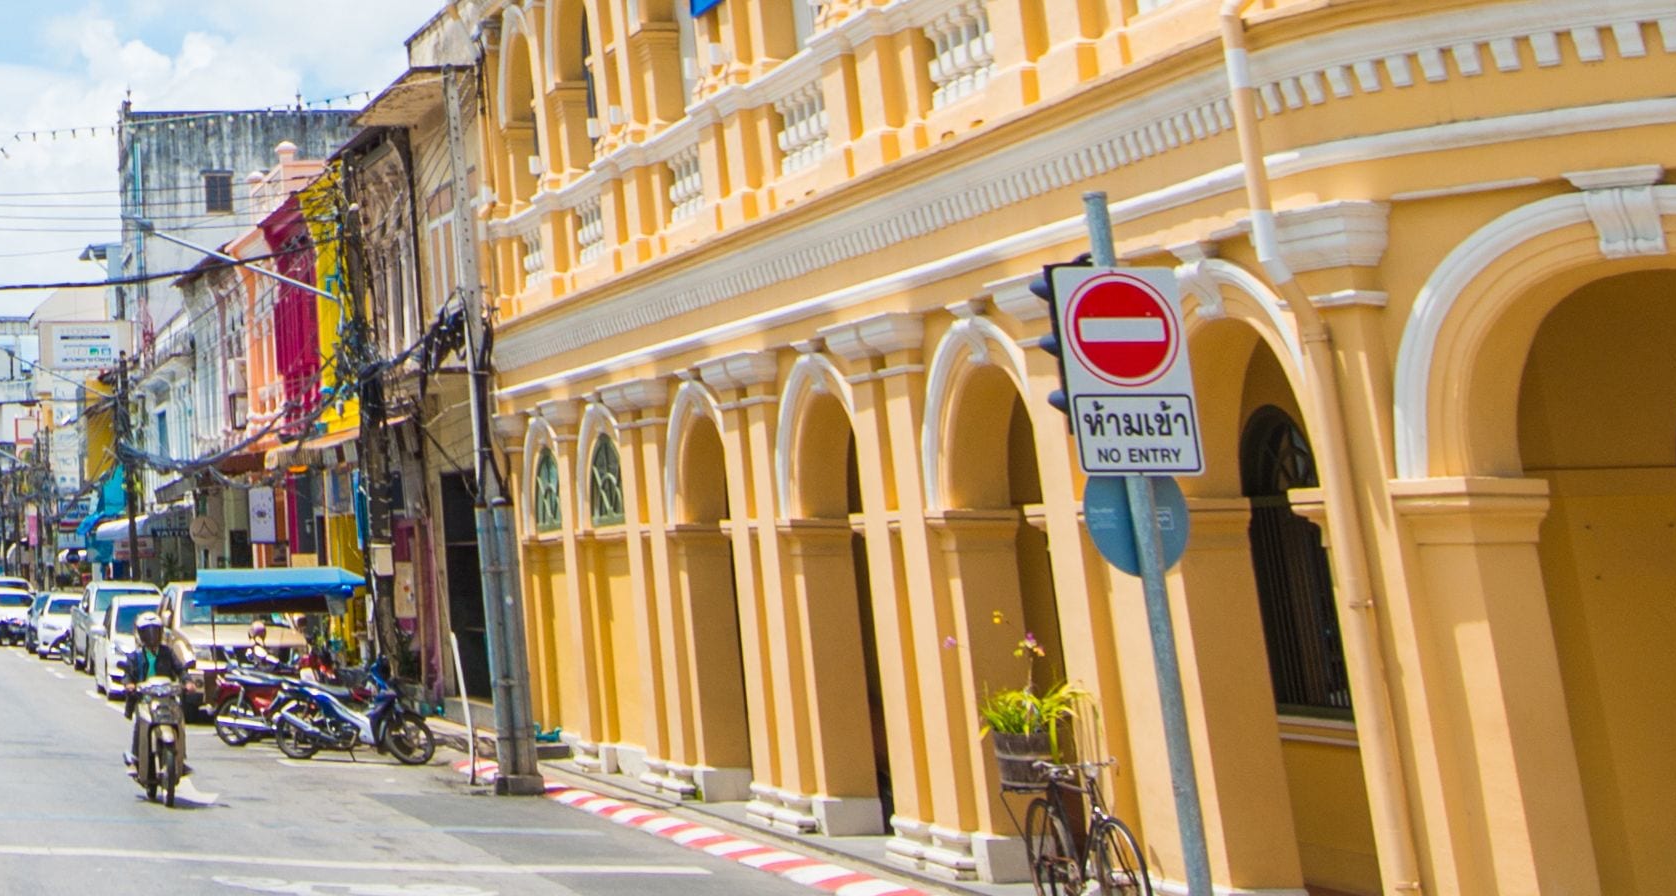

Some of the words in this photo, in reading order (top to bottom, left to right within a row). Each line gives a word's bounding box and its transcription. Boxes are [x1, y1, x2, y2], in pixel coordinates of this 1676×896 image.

[1083, 400, 1190, 437] ห้ามเข้า
[1097, 448, 1121, 463] NO
[1128, 447, 1181, 463] ENTRY
